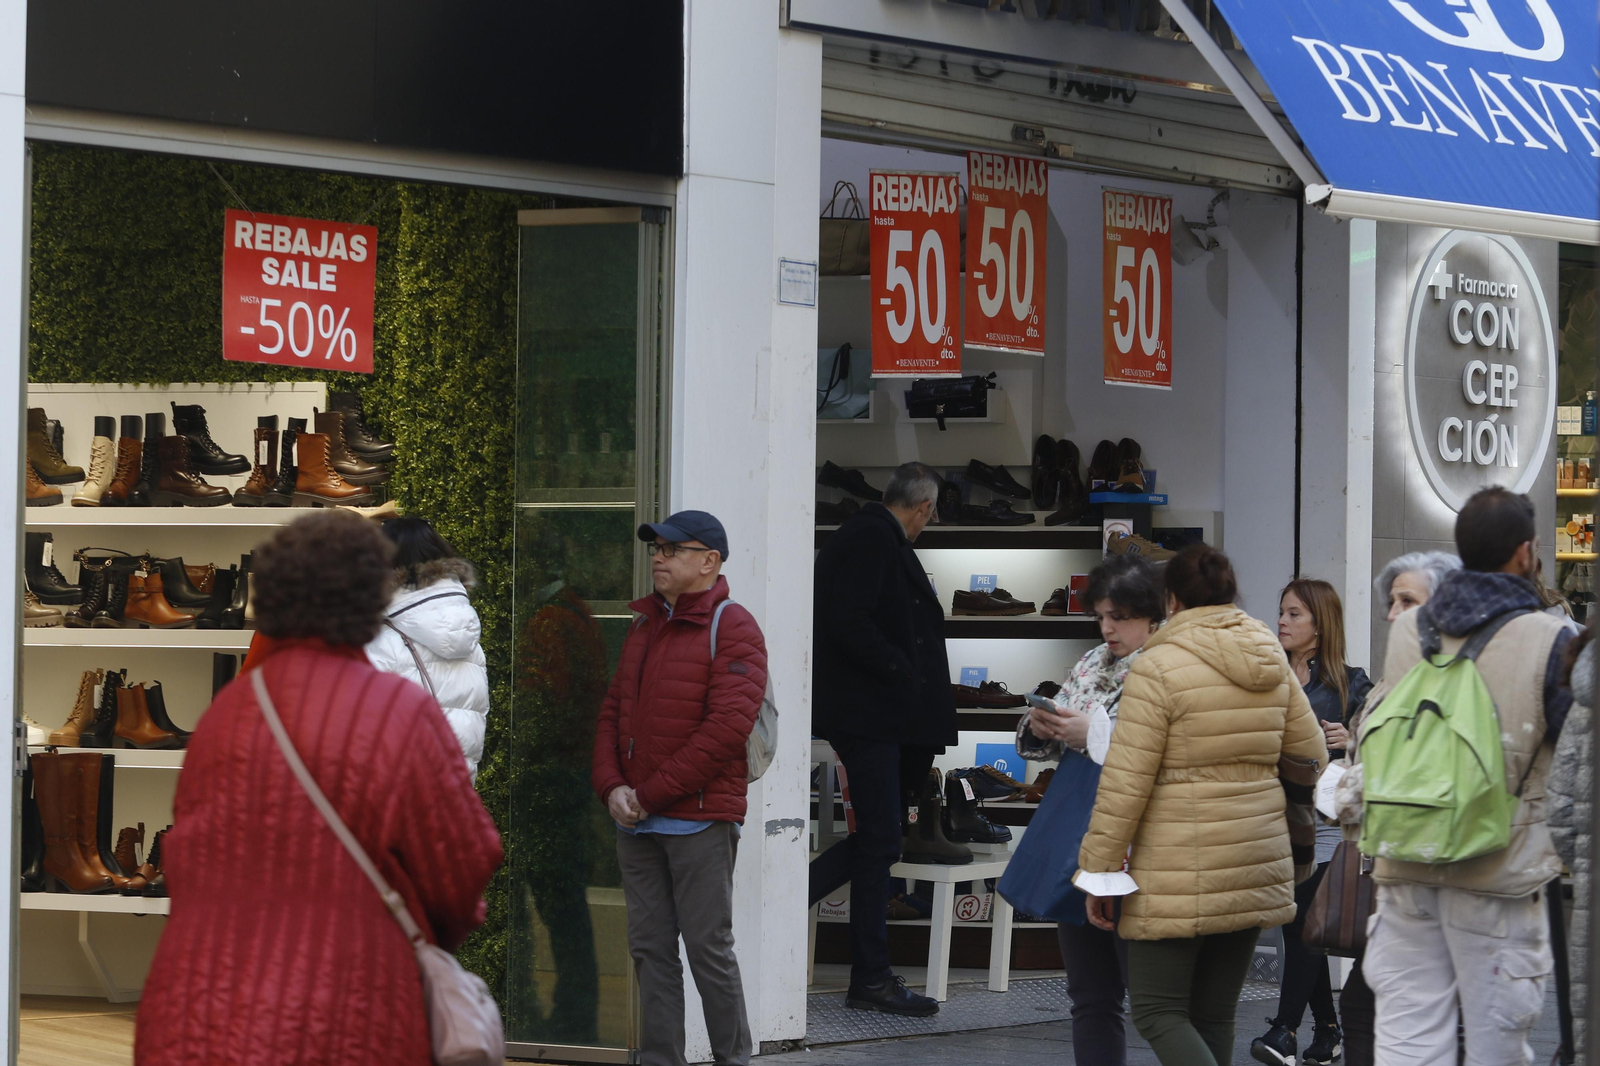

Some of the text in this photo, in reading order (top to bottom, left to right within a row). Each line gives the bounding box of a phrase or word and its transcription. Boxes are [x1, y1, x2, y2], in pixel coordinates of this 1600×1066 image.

[1291, 34, 1600, 158] BENAVE
[969, 152, 1047, 198] REBAJAS
[872, 175, 958, 218] REBAJAS
[972, 191, 989, 202] hasta
[874, 216, 895, 226] hasta
[1105, 192, 1171, 237] REBAJAS
[234, 219, 368, 263] REBAJAS
[1106, 231, 1122, 242] hasta
[261, 257, 338, 292] SALE
[1456, 273, 1519, 299] Farmacia
[240, 295, 260, 304] HASTA
[240, 298, 357, 363] -50%
[1026, 326, 1040, 338] dto.
[1449, 299, 1520, 350] CON
[900, 358, 936, 367] BENAVENTE
[940, 349, 956, 359] dto.
[1156, 360, 1168, 372] dto.
[1463, 359, 1519, 408] CEP
[1438, 413, 1519, 468] CIÓN
[977, 576, 991, 585] PIEL
[820, 908, 846, 916] Rebajas
[980, 892, 991, 920] Rebajas
